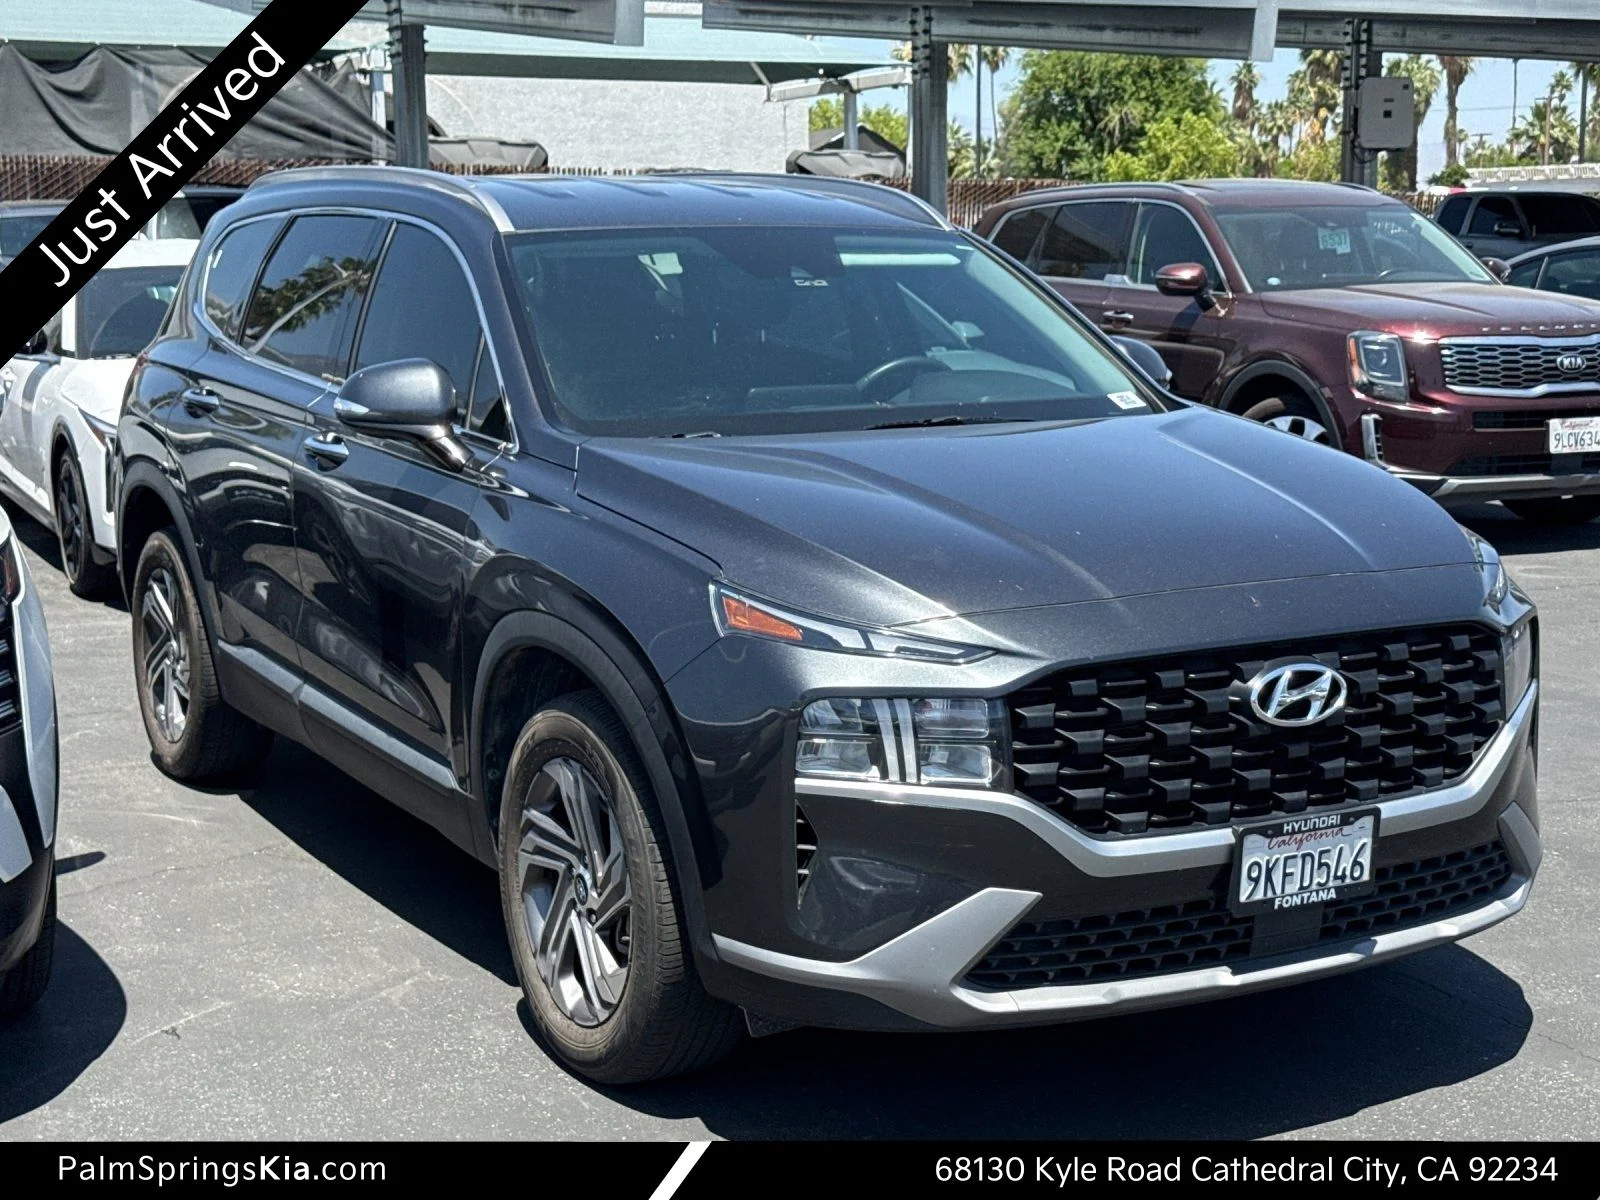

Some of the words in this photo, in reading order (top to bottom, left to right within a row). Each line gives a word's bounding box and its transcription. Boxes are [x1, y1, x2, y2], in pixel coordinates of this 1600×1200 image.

[1562, 356, 1585, 369] KIA
[1553, 430, 1600, 449] 9LCV634
[1283, 814, 1341, 834] HYUNDAI
[1267, 827, 1352, 851] California
[1244, 841, 1369, 901] 9KFD546
[1274, 888, 1337, 910] FONTANA
